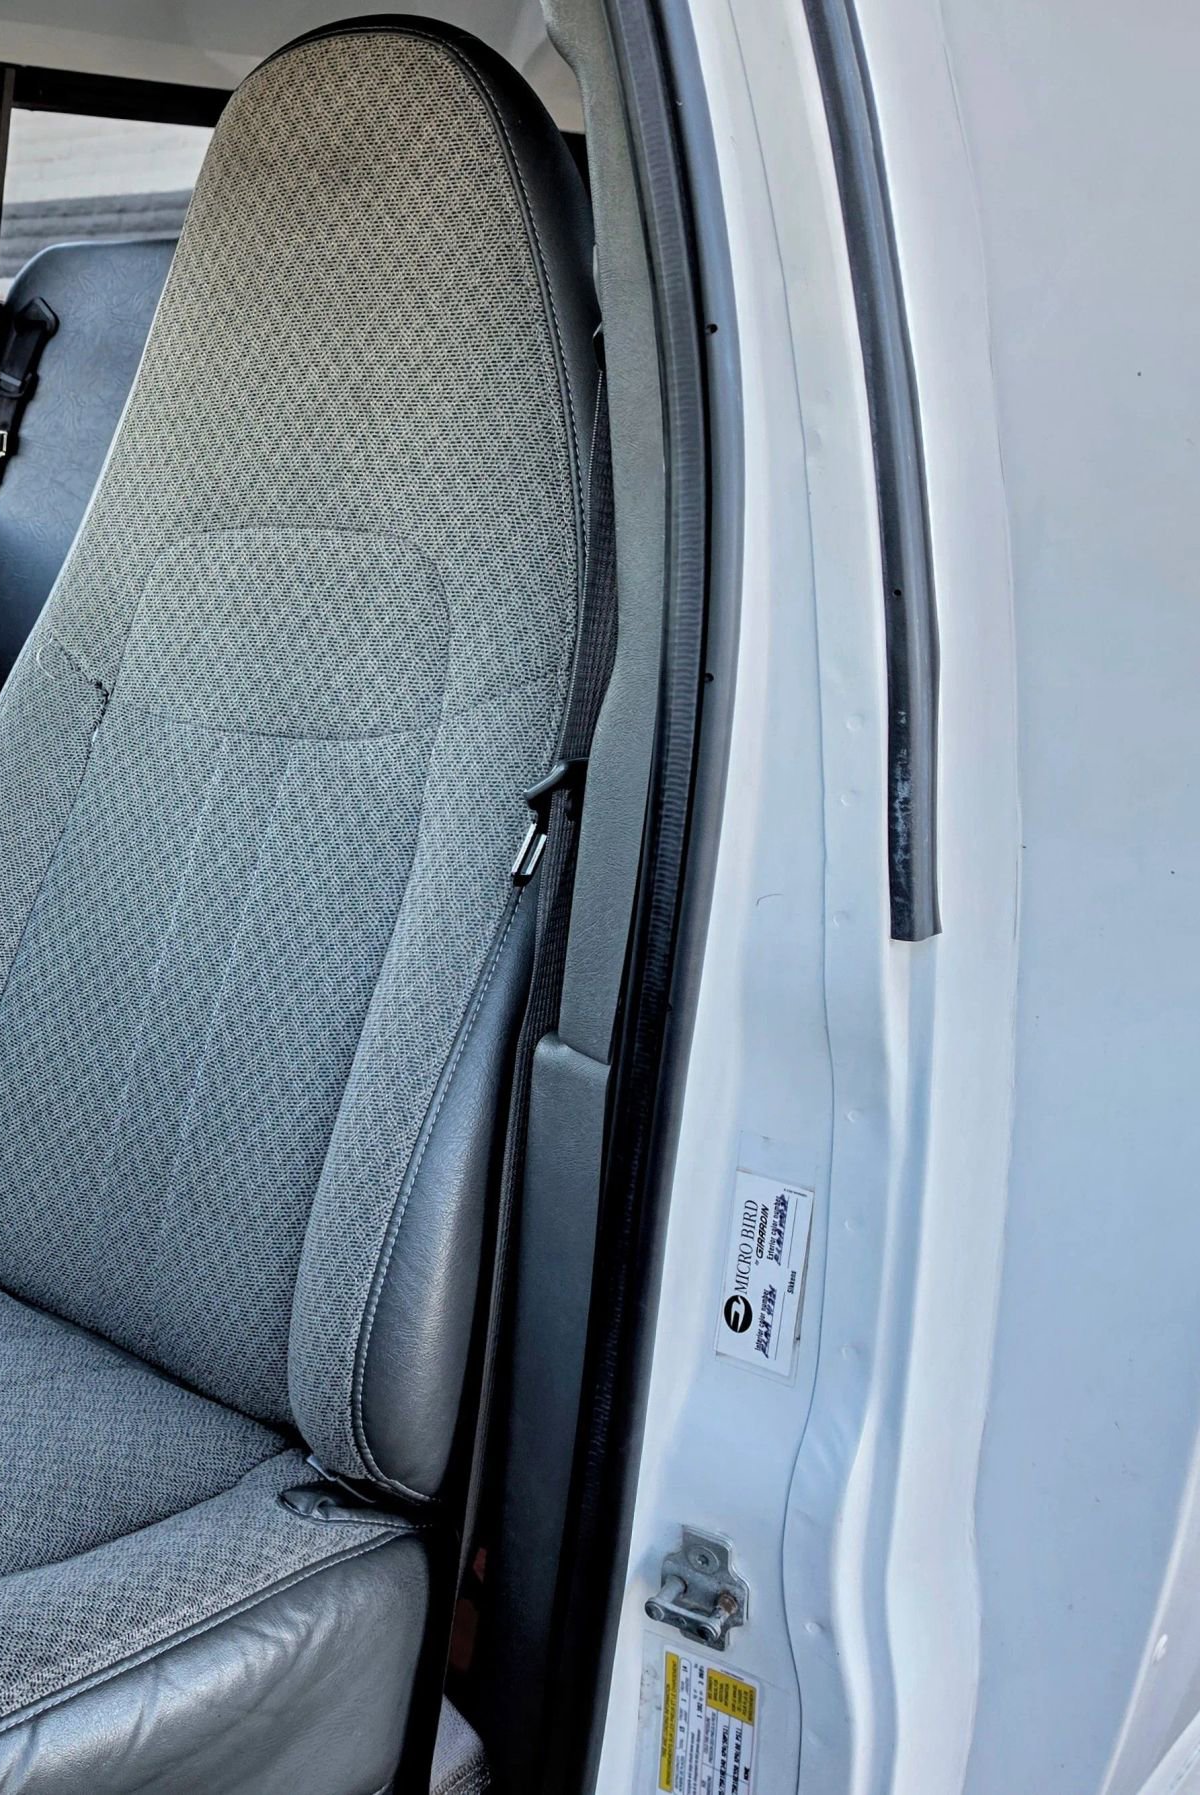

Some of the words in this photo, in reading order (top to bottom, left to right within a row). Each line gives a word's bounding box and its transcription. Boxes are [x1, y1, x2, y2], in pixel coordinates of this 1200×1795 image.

[740, 1199, 759, 1241] BIRD
[773, 1195, 781, 1220] number
[755, 1204, 769, 1260] GIRARDIN
[770, 1219, 778, 1236] color
[766, 1236, 776, 1261] Exterior
[734, 1243, 753, 1295] MICRO
[786, 1270, 797, 1295] Sikkens
[761, 1288, 769, 1312] number
[758, 1312, 766, 1328] color
[754, 1328, 763, 1351] Interior
